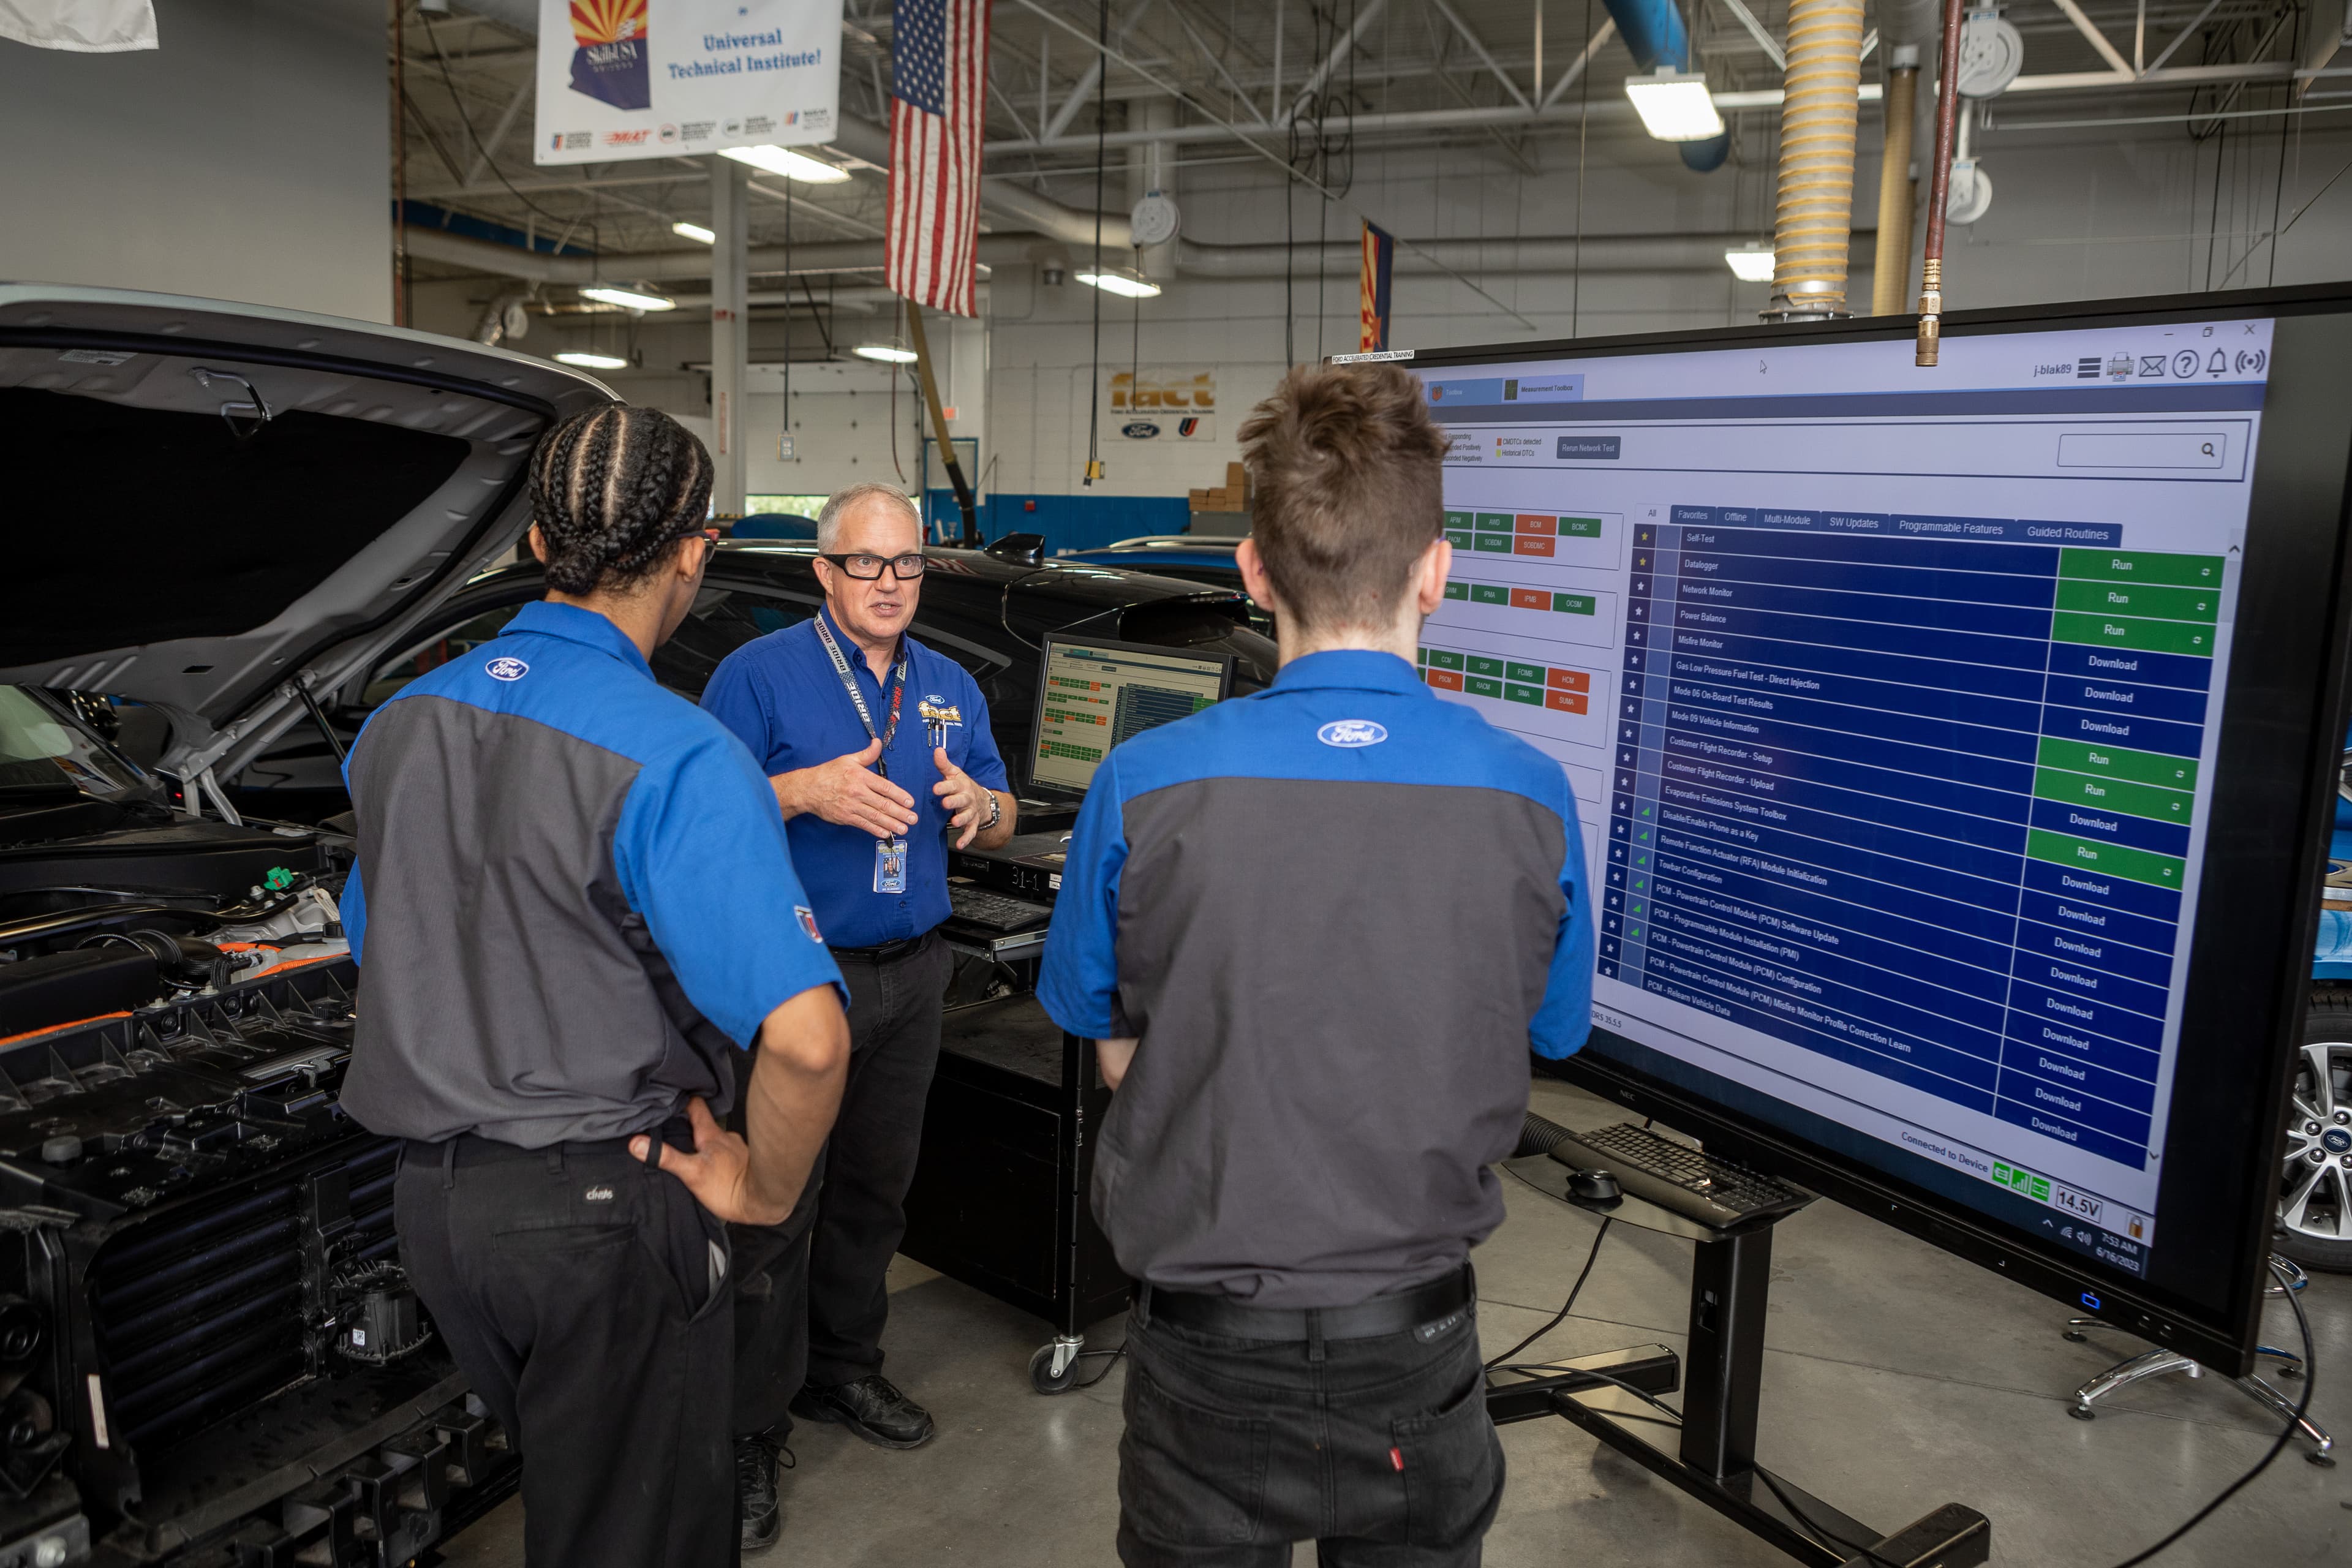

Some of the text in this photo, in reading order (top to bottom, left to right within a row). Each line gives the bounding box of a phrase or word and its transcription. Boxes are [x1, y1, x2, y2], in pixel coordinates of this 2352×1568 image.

[703, 28, 783, 51] Universal
[668, 48, 821, 79] Technical Institute!
[2034, 363, 2071, 377] j-blak89
[1110, 372, 1215, 407] fact
[1128, 423, 1154, 437] Ford
[1648, 509, 1656, 518] All
[1678, 510, 1708, 520] Favorites
[1724, 512, 1747, 522] Offline
[1764, 514, 1811, 525] Multi-Module
[1830, 517, 1879, 529] SW Updates
[1899, 520, 2003, 535] Programmable Features
[1687, 533, 1715, 544] Self-Test
[2027, 526, 2109, 540] Guided Routines
[1524, 541, 1545, 550] SOBDMC
[1684, 559, 1719, 571] Datalogger
[2112, 559, 2132, 570] Run
[1683, 584, 1733, 598] Network Monitor
[1681, 610, 1726, 624] Power Balance
[816, 620, 832, 644] BRIDE
[1678, 636, 1724, 649] Misfire Monitor
[829, 644, 846, 672] BRIDE
[2089, 655, 2138, 671] Download
[492, 660, 522, 677] Ford
[1676, 661, 1820, 690] Gas Low Pressure Fuel Test Direct Injection
[1439, 675, 1452, 684] PSCM
[1562, 676, 1574, 685] HCM
[846, 681, 870, 723] BRIDE
[1559, 696, 1574, 706] SUMA
[1674, 686, 1773, 709] Mode 06 On-Board Test Results
[918, 701, 961, 722] fact
[1672, 711, 1759, 734] Mode 09 Vehicle Information
[1331, 724, 1375, 742] Ford
[1670, 736, 1773, 765] Customer Flight Recorder Setup
[2089, 752, 2109, 764] Run
[1665, 786, 1787, 821] Evaporative Emissions System Toolbox
[1663, 810, 1708, 828] Disable/Enable
[1709, 821, 1729, 834] Phone
[1746, 830, 1759, 843] Key
[2070, 813, 2117, 832] Download
[1660, 835, 1828, 886] Remote Function Actuator (RFA) Module Initialization
[2078, 846, 2097, 860] Run
[1659, 859, 1722, 884] Towbar Configuration
[1656, 884, 1839, 944] PCM Powertrain Control Module (PCM) Software Update
[1647, 980, 1731, 1017] PCM Relearn Vehicle Data
[1649, 956, 1911, 1053] PCM Powertrain Control Module (PCM) Misfire Monitor Profile Correction Learn
[2046, 997, 2093, 1020] Download
[1591, 1010, 1622, 1028] DRS 35.5.5
[1619, 1090, 1635, 1101] NEC
[2032, 1117, 2077, 1141] Download
[1902, 1131, 1988, 1173] Connected to Device
[2059, 1190, 2099, 1217] 14.5V
[2120, 1242, 2138, 1255] AM
